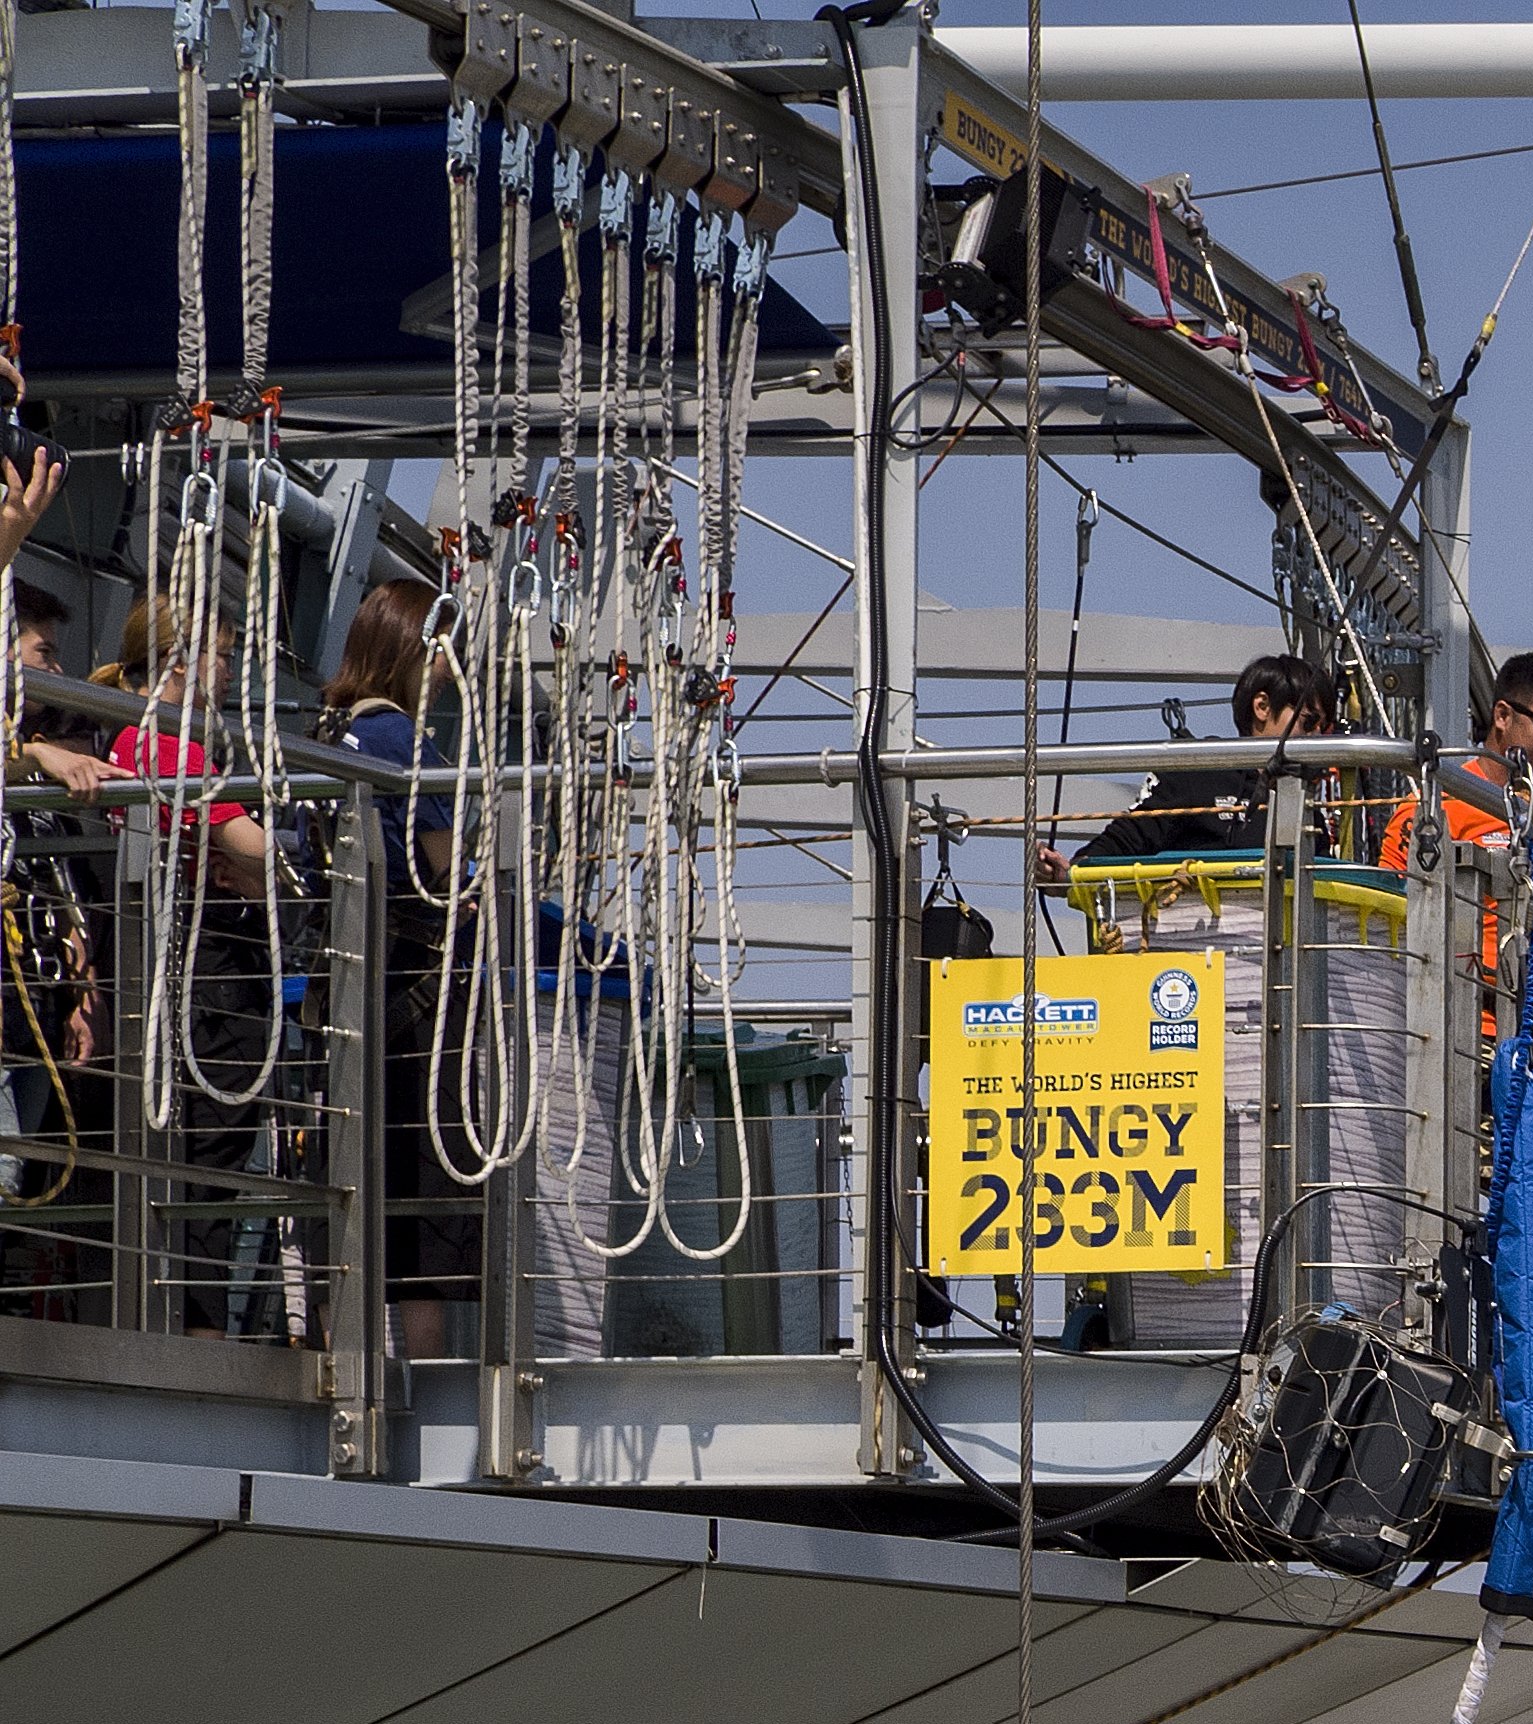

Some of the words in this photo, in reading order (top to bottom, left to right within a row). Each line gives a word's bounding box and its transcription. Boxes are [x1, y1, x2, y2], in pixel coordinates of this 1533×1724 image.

[957, 109, 1006, 165] BUNGY
[1099, 208, 1126, 249] THE
[1132, 230, 1189, 291] WOD'S
[1252, 314, 1293, 361] BUNGY
[1157, 972, 1193, 987] GUINNESS
[1153, 992, 1170, 1017] WORLD
[1170, 991, 1197, 1018] RECORDS
[1038, 1023, 1094, 1031] TOWER
[1152, 1024, 1197, 1035] RECORD
[1152, 1034, 1196, 1045] HOLDER
[963, 1077, 1002, 1094] THE
[1111, 1071, 1198, 1090] HIGHEST
[962, 1103, 1198, 1162] BUNGY
[960, 1168, 1197, 1250] 233M
